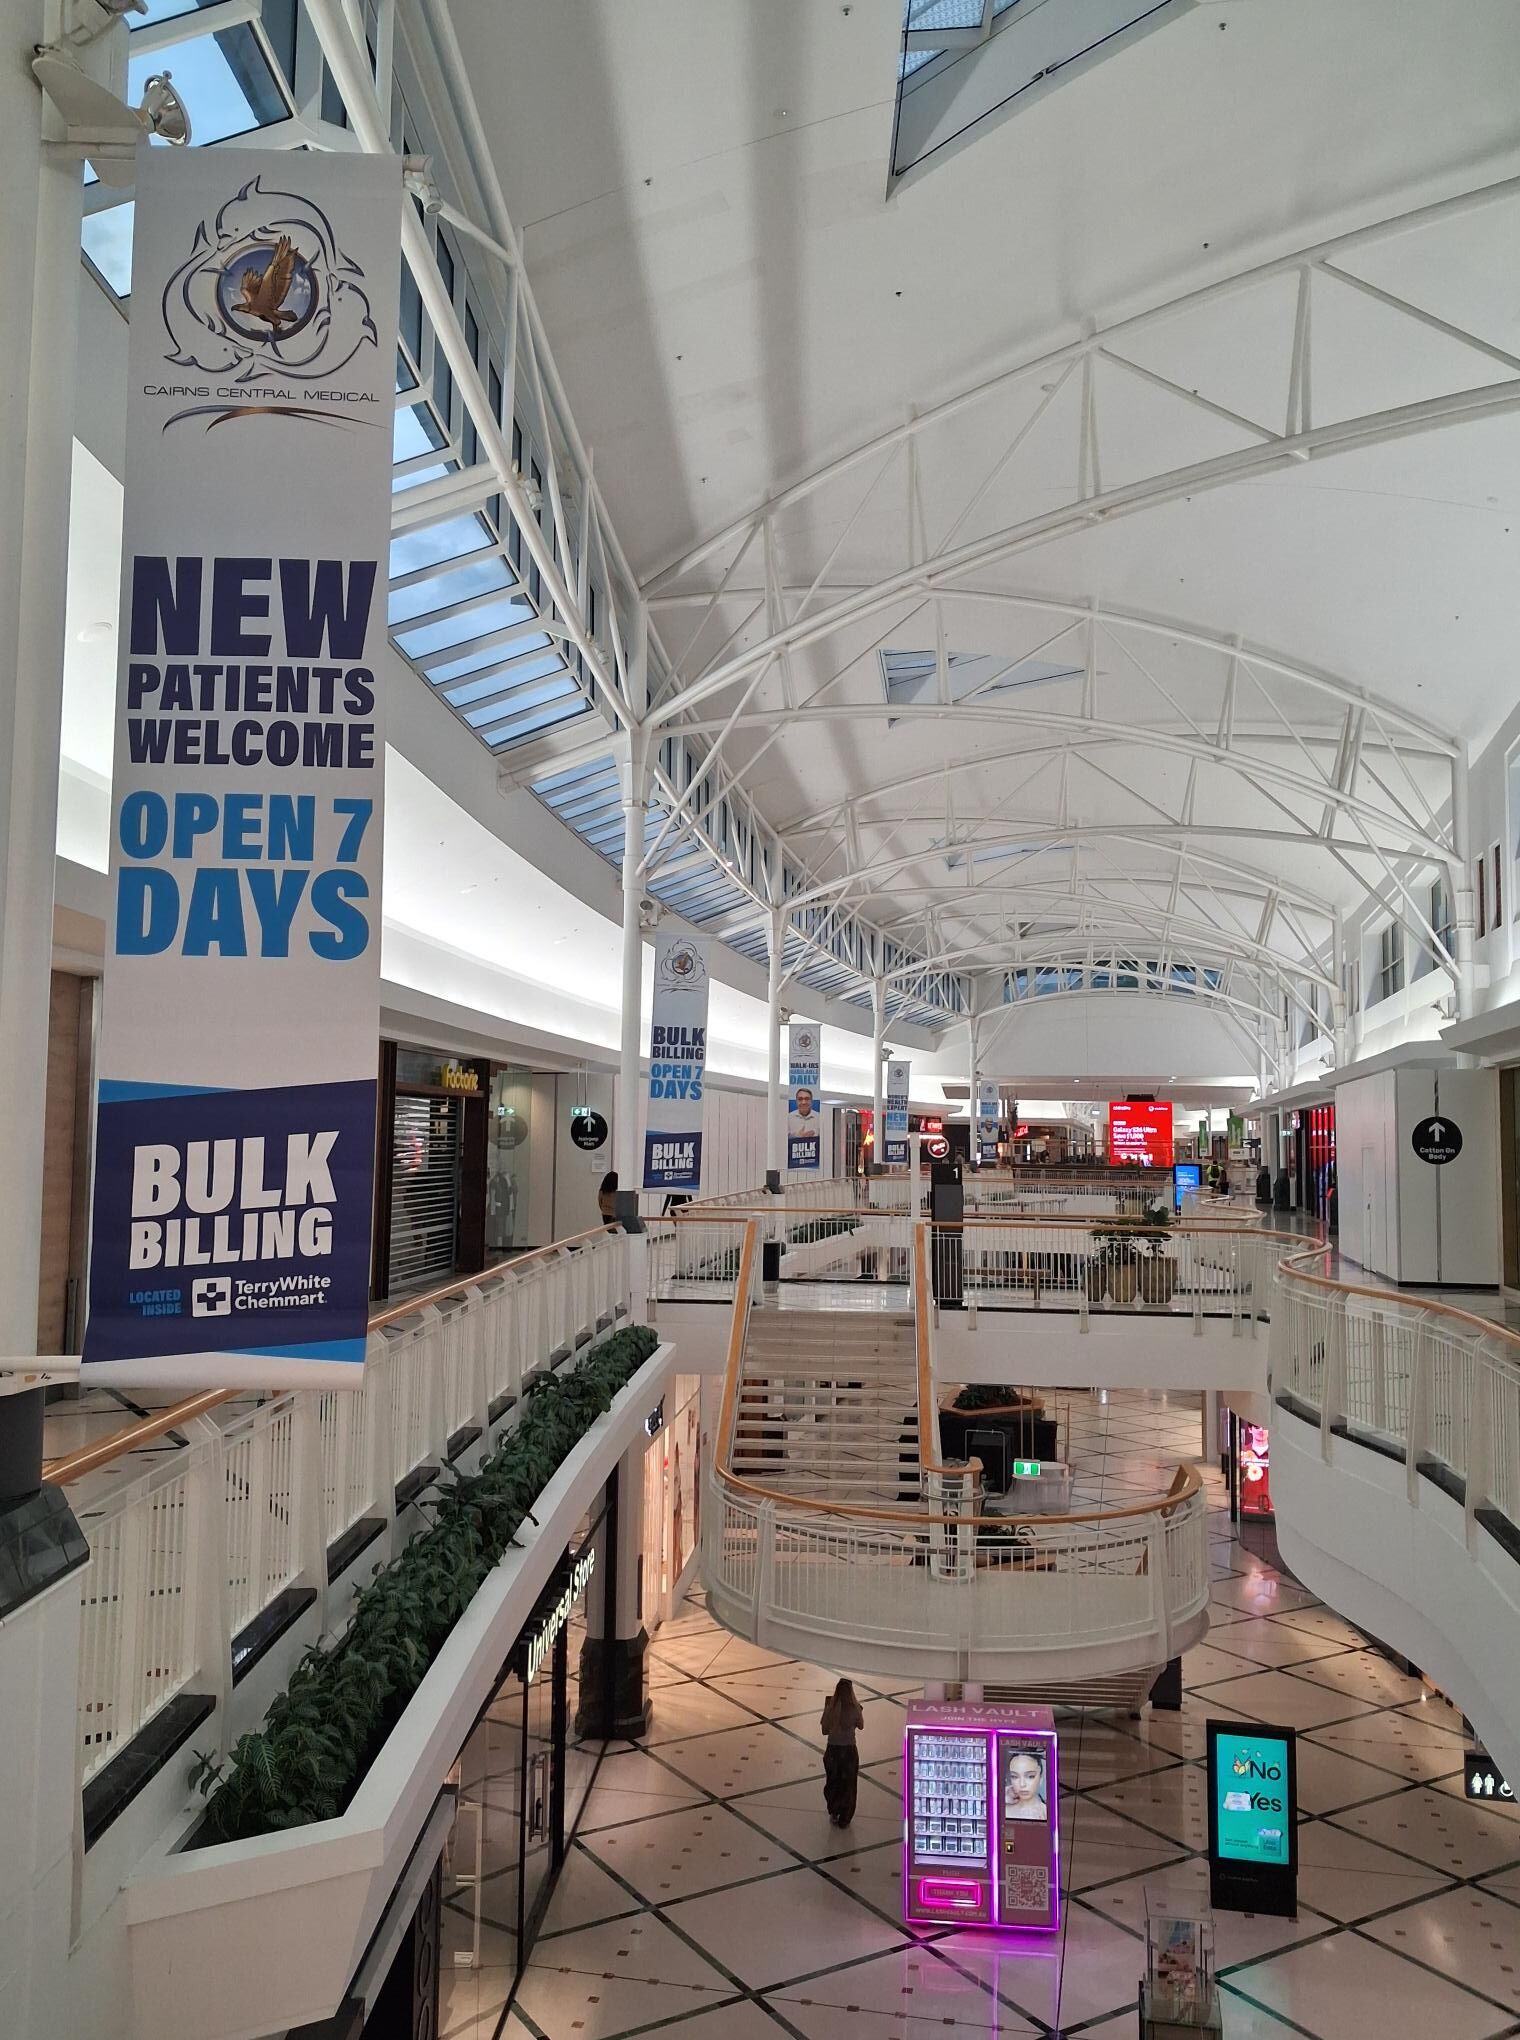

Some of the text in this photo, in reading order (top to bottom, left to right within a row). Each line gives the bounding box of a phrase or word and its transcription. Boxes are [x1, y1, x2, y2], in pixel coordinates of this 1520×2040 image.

[143, 385, 380, 402] CAIRNS CENTRAL MEDICAL
[129, 555, 378, 660] NEW
[128, 664, 375, 716] PATIENTS
[128, 718, 375, 769] WELCOME
[119, 790, 373, 863] OPEN 7
[115, 866, 370, 960] DAYS
[653, 1026, 705, 1046] BULK
[652, 1046, 704, 1060] BILLING
[651, 1063, 704, 1080] OPEN 7
[790, 1074, 818, 1085] DAILY
[650, 1079, 702, 1100] DAYS
[652, 1142, 695, 1160] BULK
[792, 1142, 816, 1152] BULK
[792, 1150, 816, 1158] BILLING
[651, 1158, 694, 1170] BILLING
[953, 1167, 958, 1179] 1
[131, 1131, 340, 1218] BULK
[129, 1207, 334, 1270] BILLING
[235, 1274, 332, 1296] TerryWhite
[130, 1289, 181, 1304] LOCATED
[235, 1290, 325, 1310] Chemmart
[142, 1303, 182, 1316] INSIDE
[528, 1548, 595, 1683] Universal Store
[912, 1704, 1040, 1718] LASH VAULT
[1250, 1760, 1281, 1780] No
[1245, 1791, 1282, 1812] Yes
